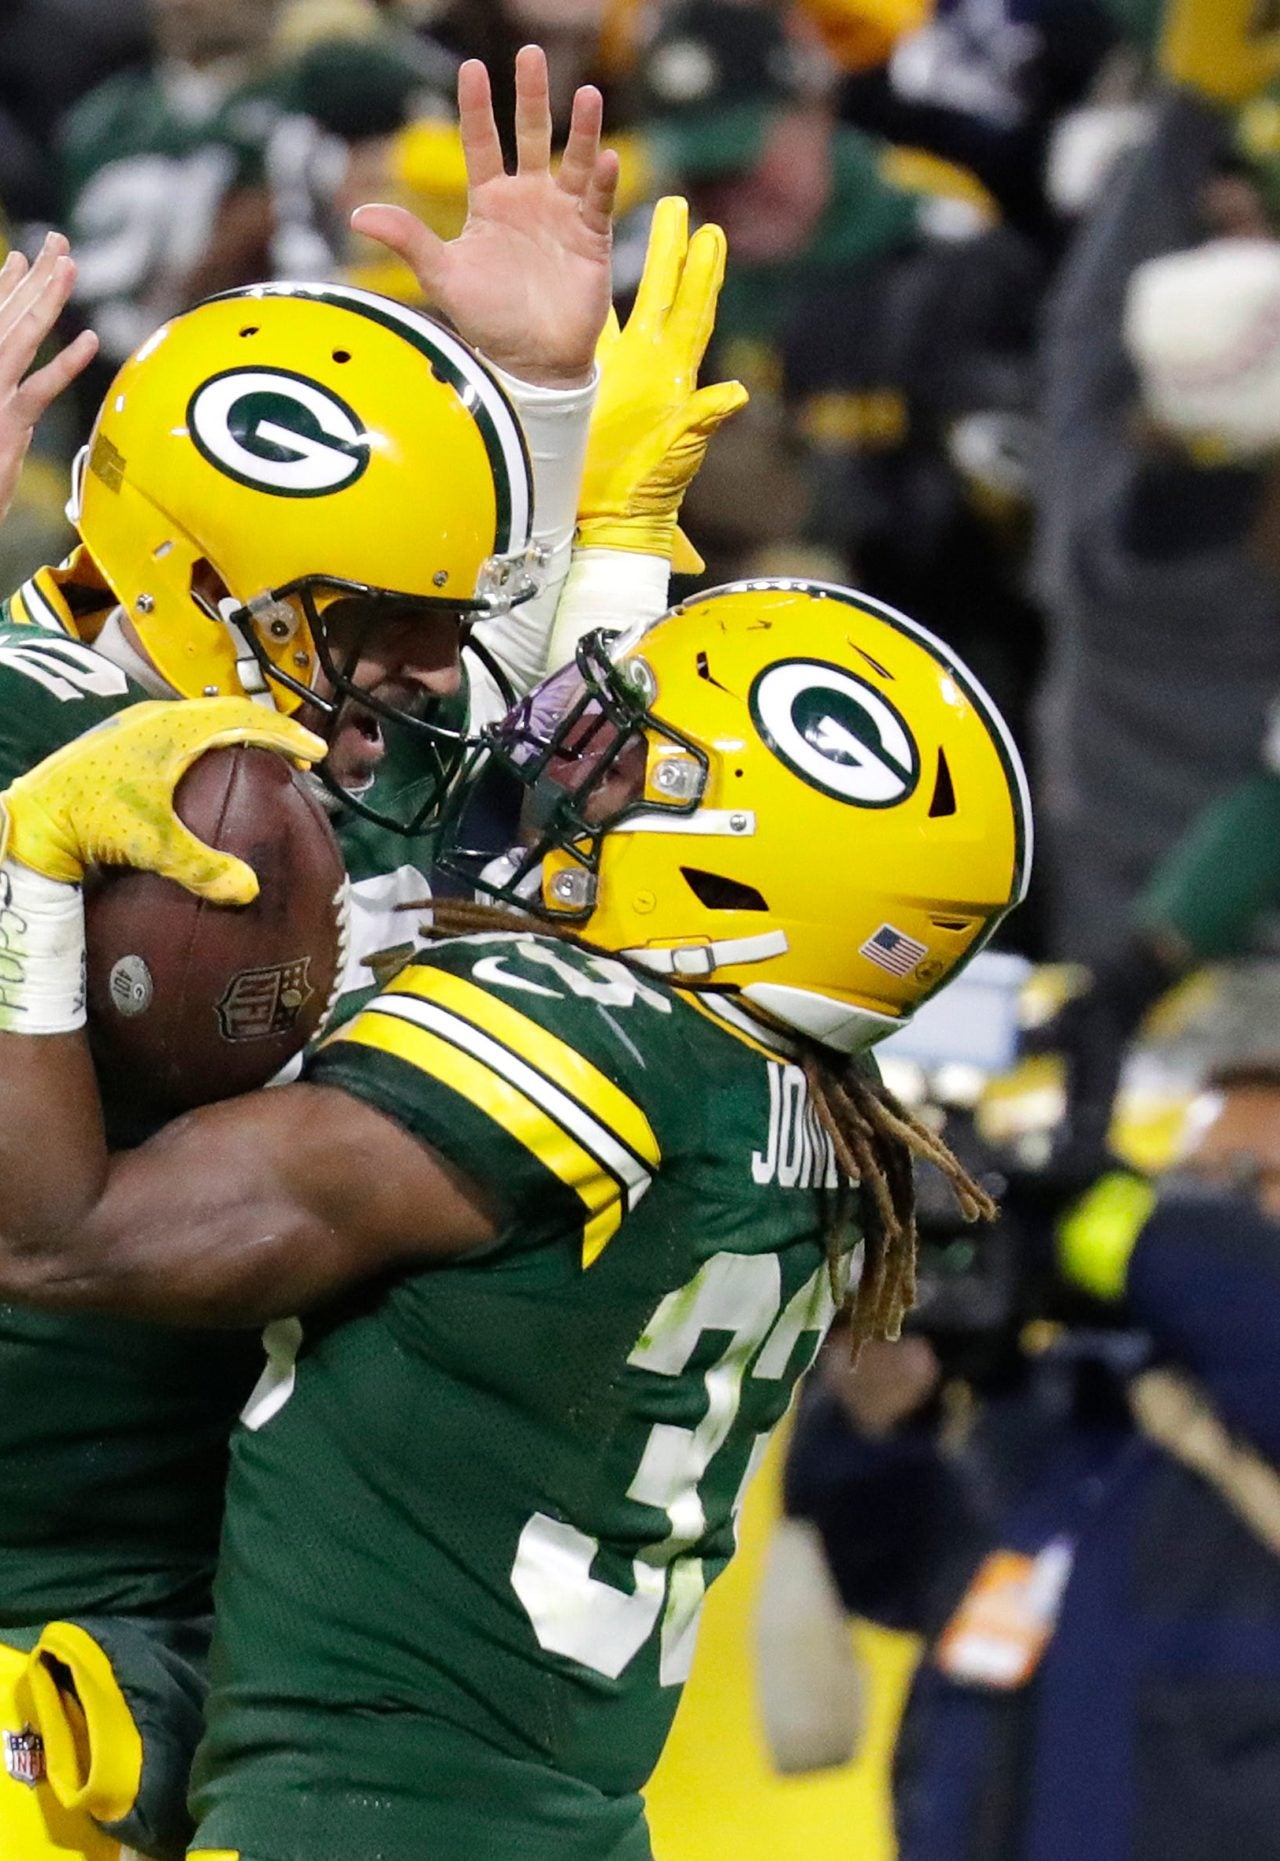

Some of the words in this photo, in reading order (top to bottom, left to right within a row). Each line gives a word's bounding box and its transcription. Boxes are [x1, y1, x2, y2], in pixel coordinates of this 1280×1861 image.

[186, 365, 370, 498] G
[748, 657, 920, 810] G
[751, 1061, 862, 1189] JON
